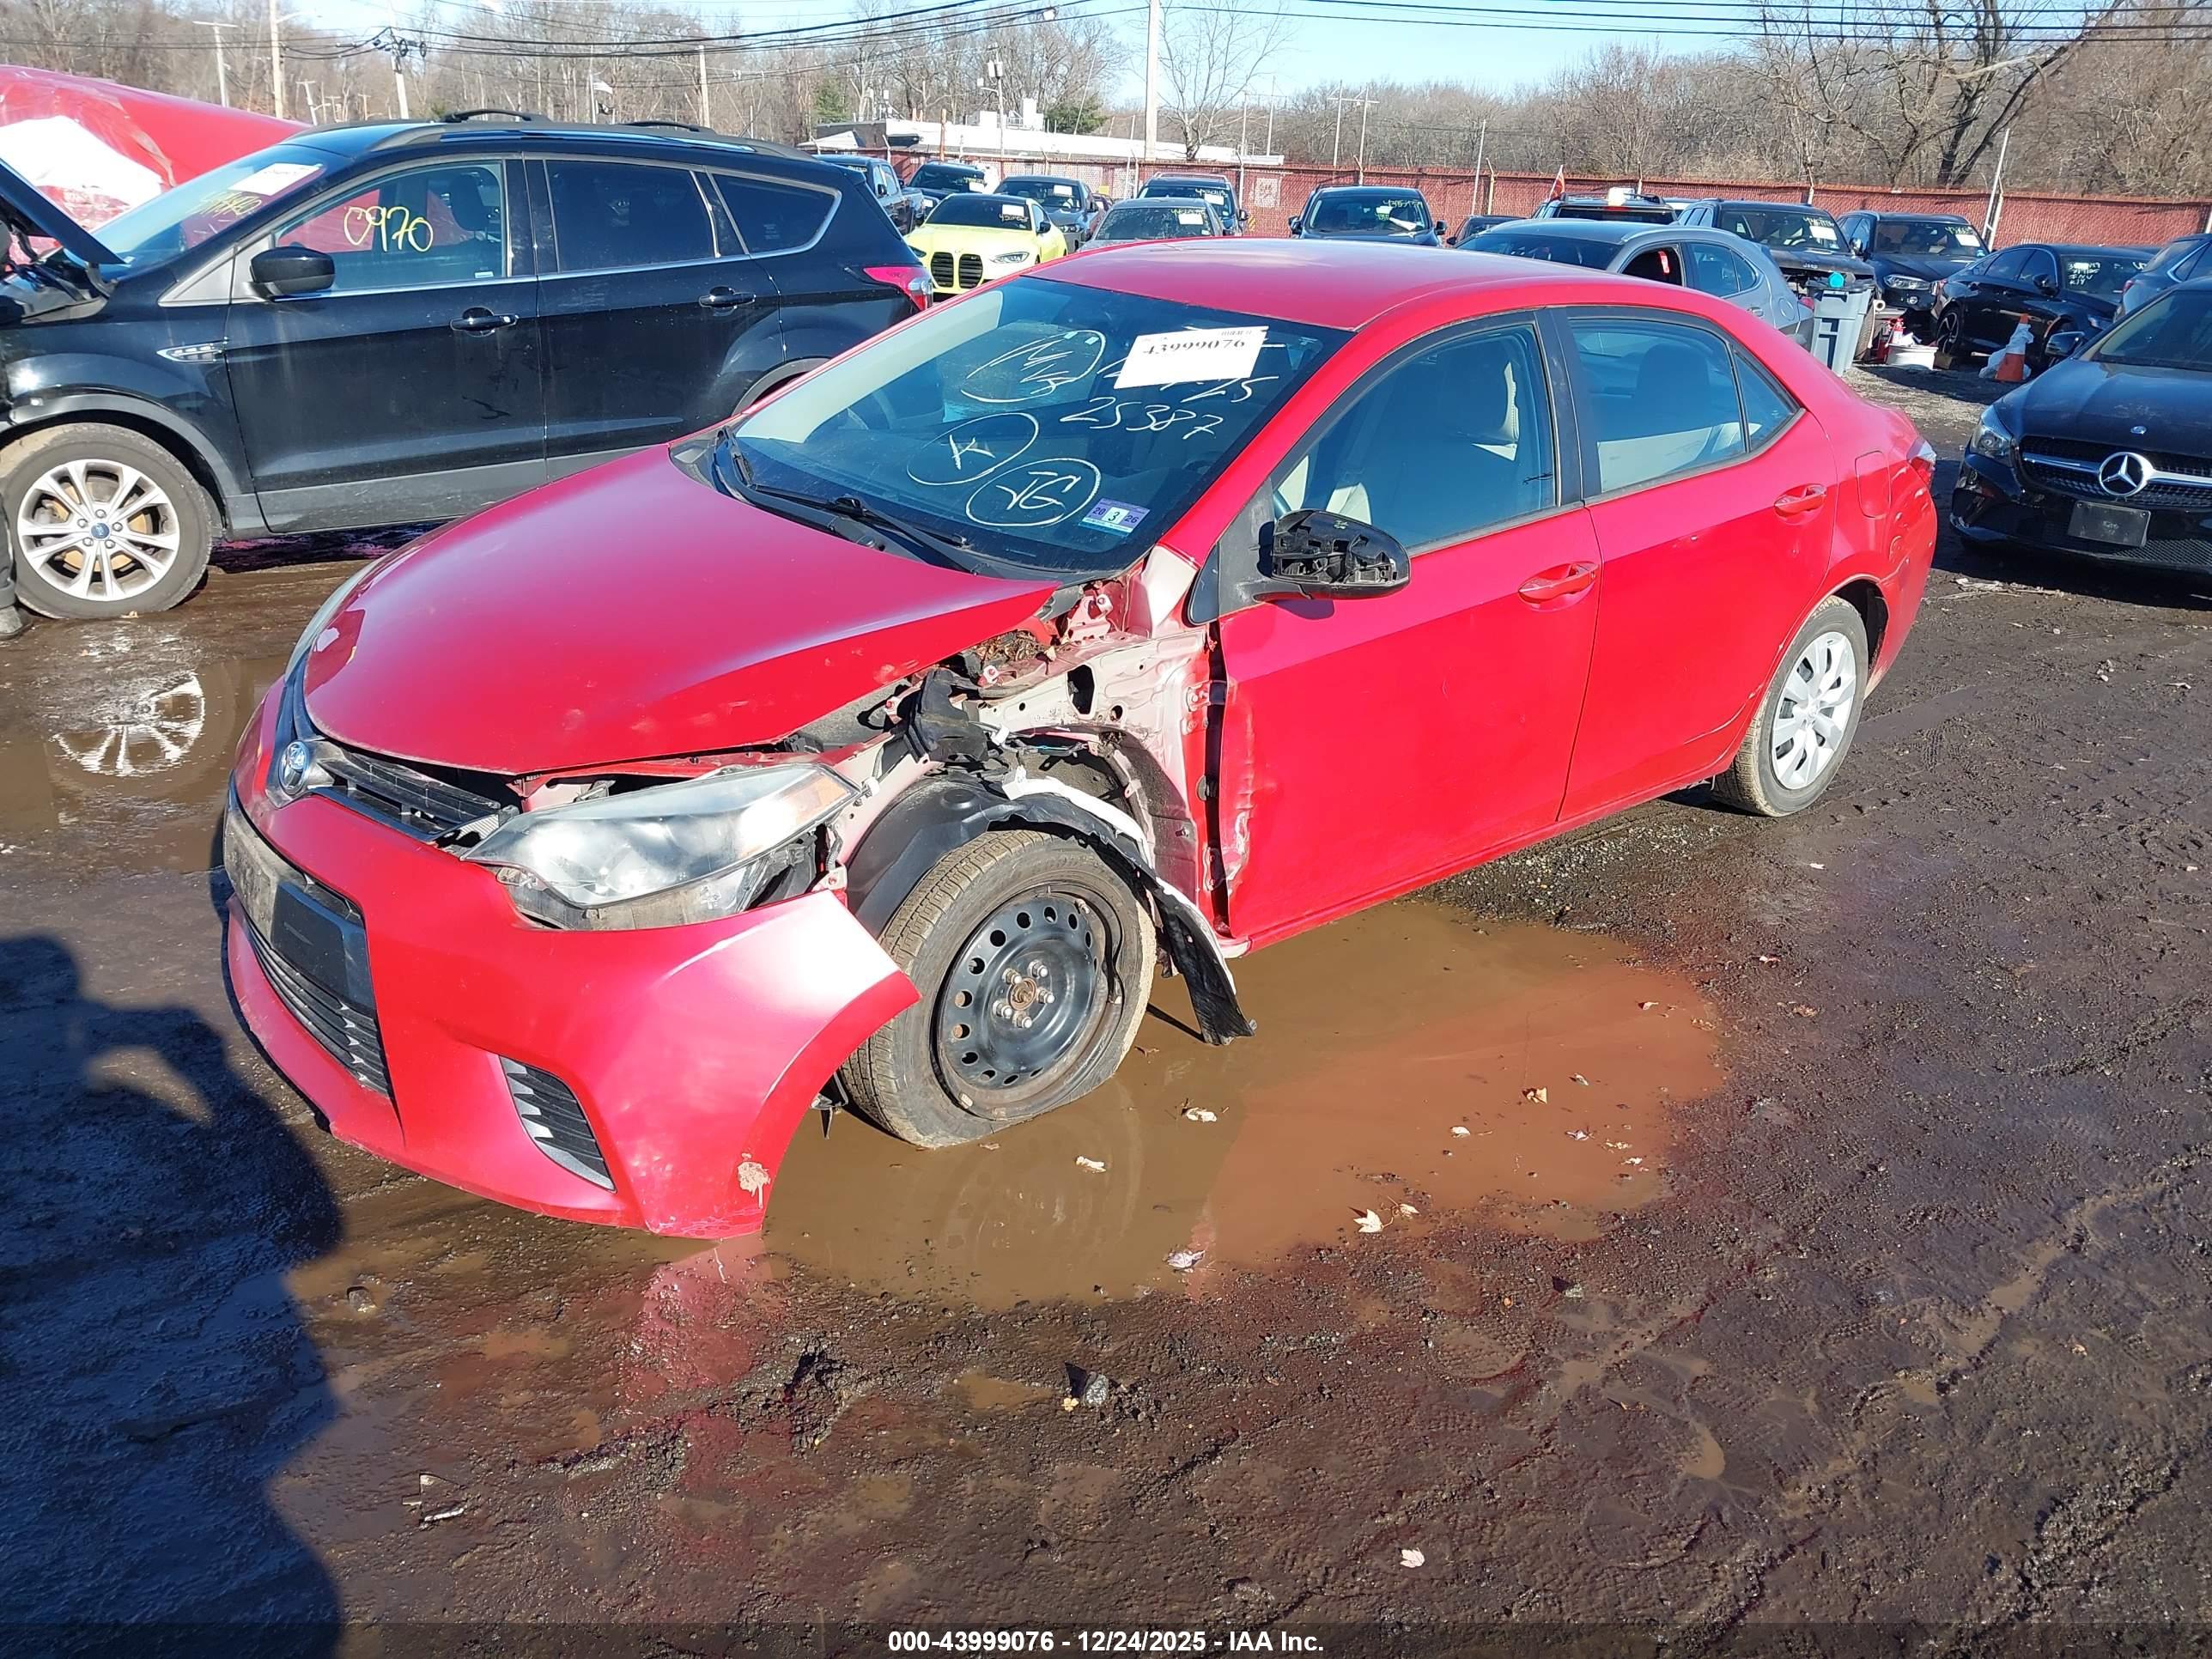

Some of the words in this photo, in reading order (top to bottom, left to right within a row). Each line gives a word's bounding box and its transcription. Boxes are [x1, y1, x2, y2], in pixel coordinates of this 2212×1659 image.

[343, 206, 434, 252] 0970
[1142, 338, 1246, 355] 43999076
[1060, 397, 1224, 440] 25387
[1092, 507, 1107, 516] 20
[1108, 511, 1121, 521] 3
[1124, 514, 1139, 524] 26
